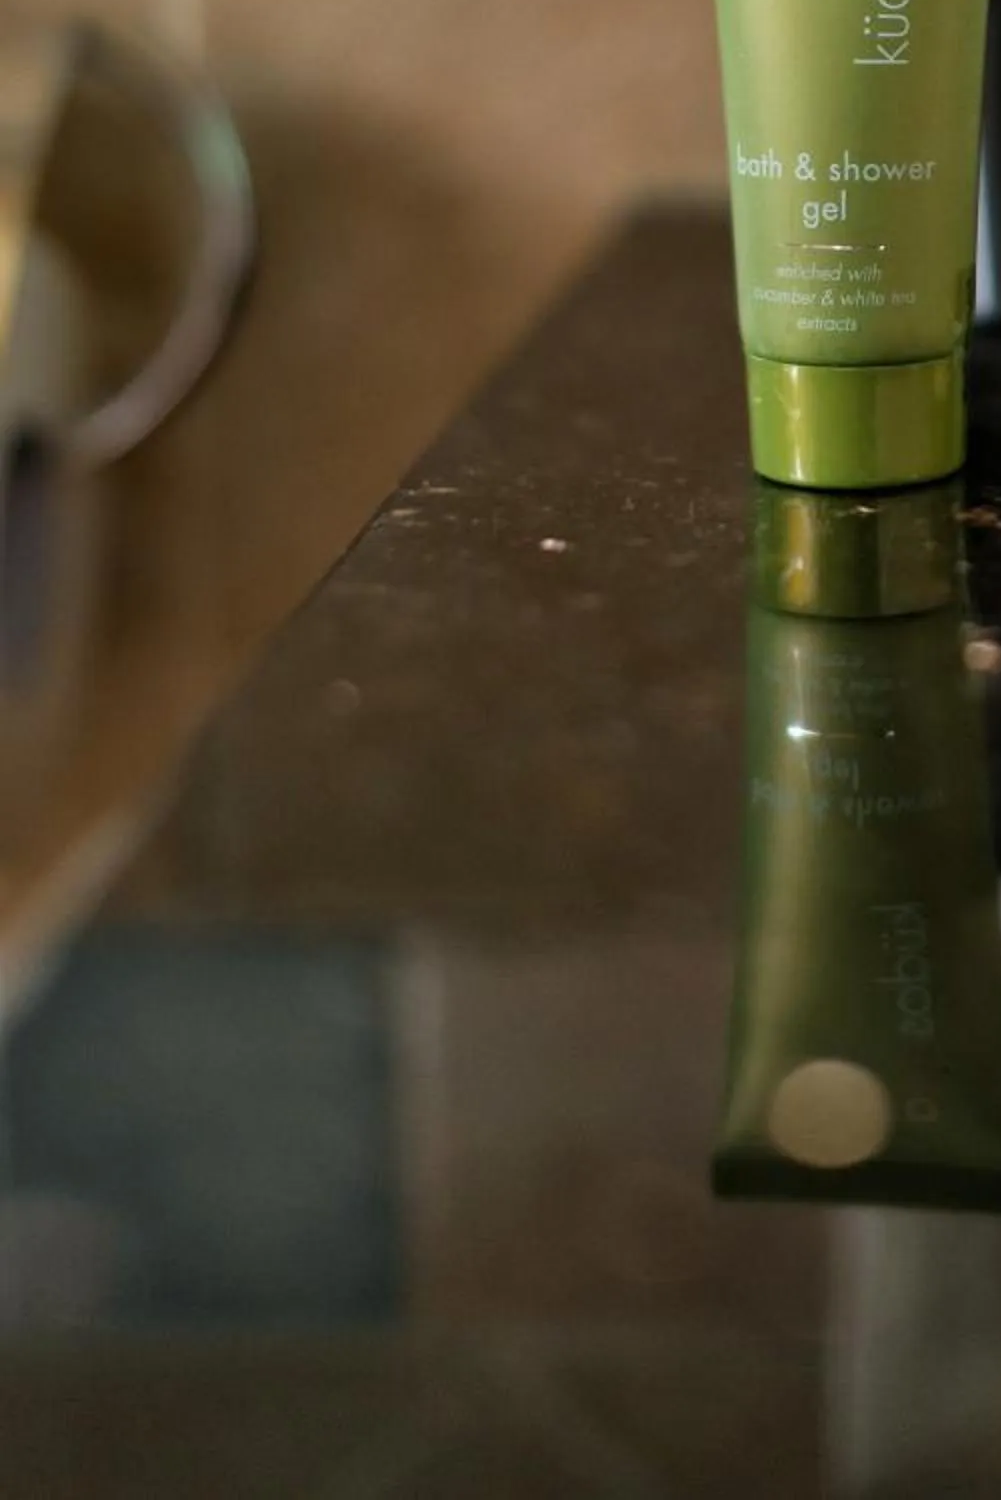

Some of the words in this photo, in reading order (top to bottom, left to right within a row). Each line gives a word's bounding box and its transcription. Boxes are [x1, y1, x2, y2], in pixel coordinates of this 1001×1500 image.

[736, 144, 783, 180] bath
[794, 152, 816, 182] &
[829, 150, 937, 181] shower
[802, 188, 847, 229] gel
[847, 263, 882, 285] with
[820, 288, 835, 307] &
